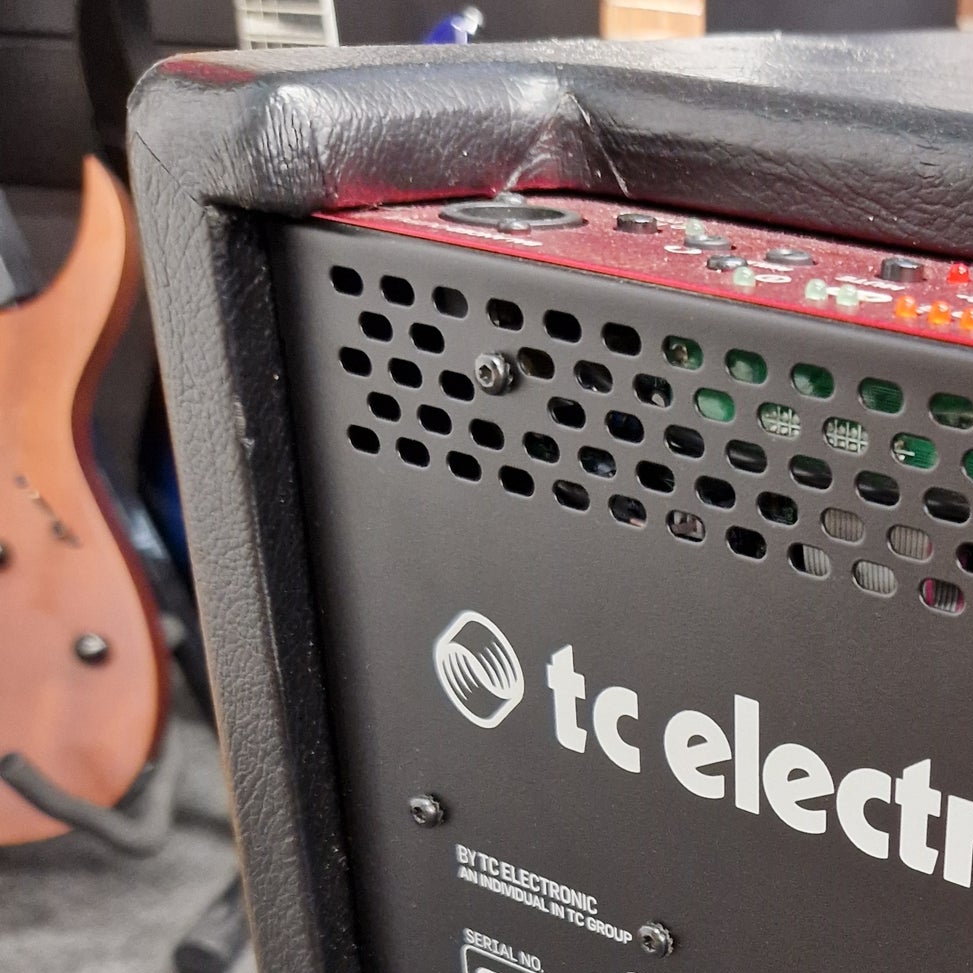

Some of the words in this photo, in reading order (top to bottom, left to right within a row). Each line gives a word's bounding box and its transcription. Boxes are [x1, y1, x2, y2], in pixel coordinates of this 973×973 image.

[546, 643, 641, 774] tc
[456, 843, 476, 867] BY
[477, 852, 500, 876] TC
[500, 861, 599, 915] ELECTRONIC
[457, 865, 478, 884] AN
[479, 875, 550, 913] INDIVIDUAL
[551, 904, 565, 920] IN
[566, 908, 585, 927] TC
[585, 916, 633, 945] GROUP
[463, 927, 518, 962] SERIAL
[519, 951, 545, 973] NO.
